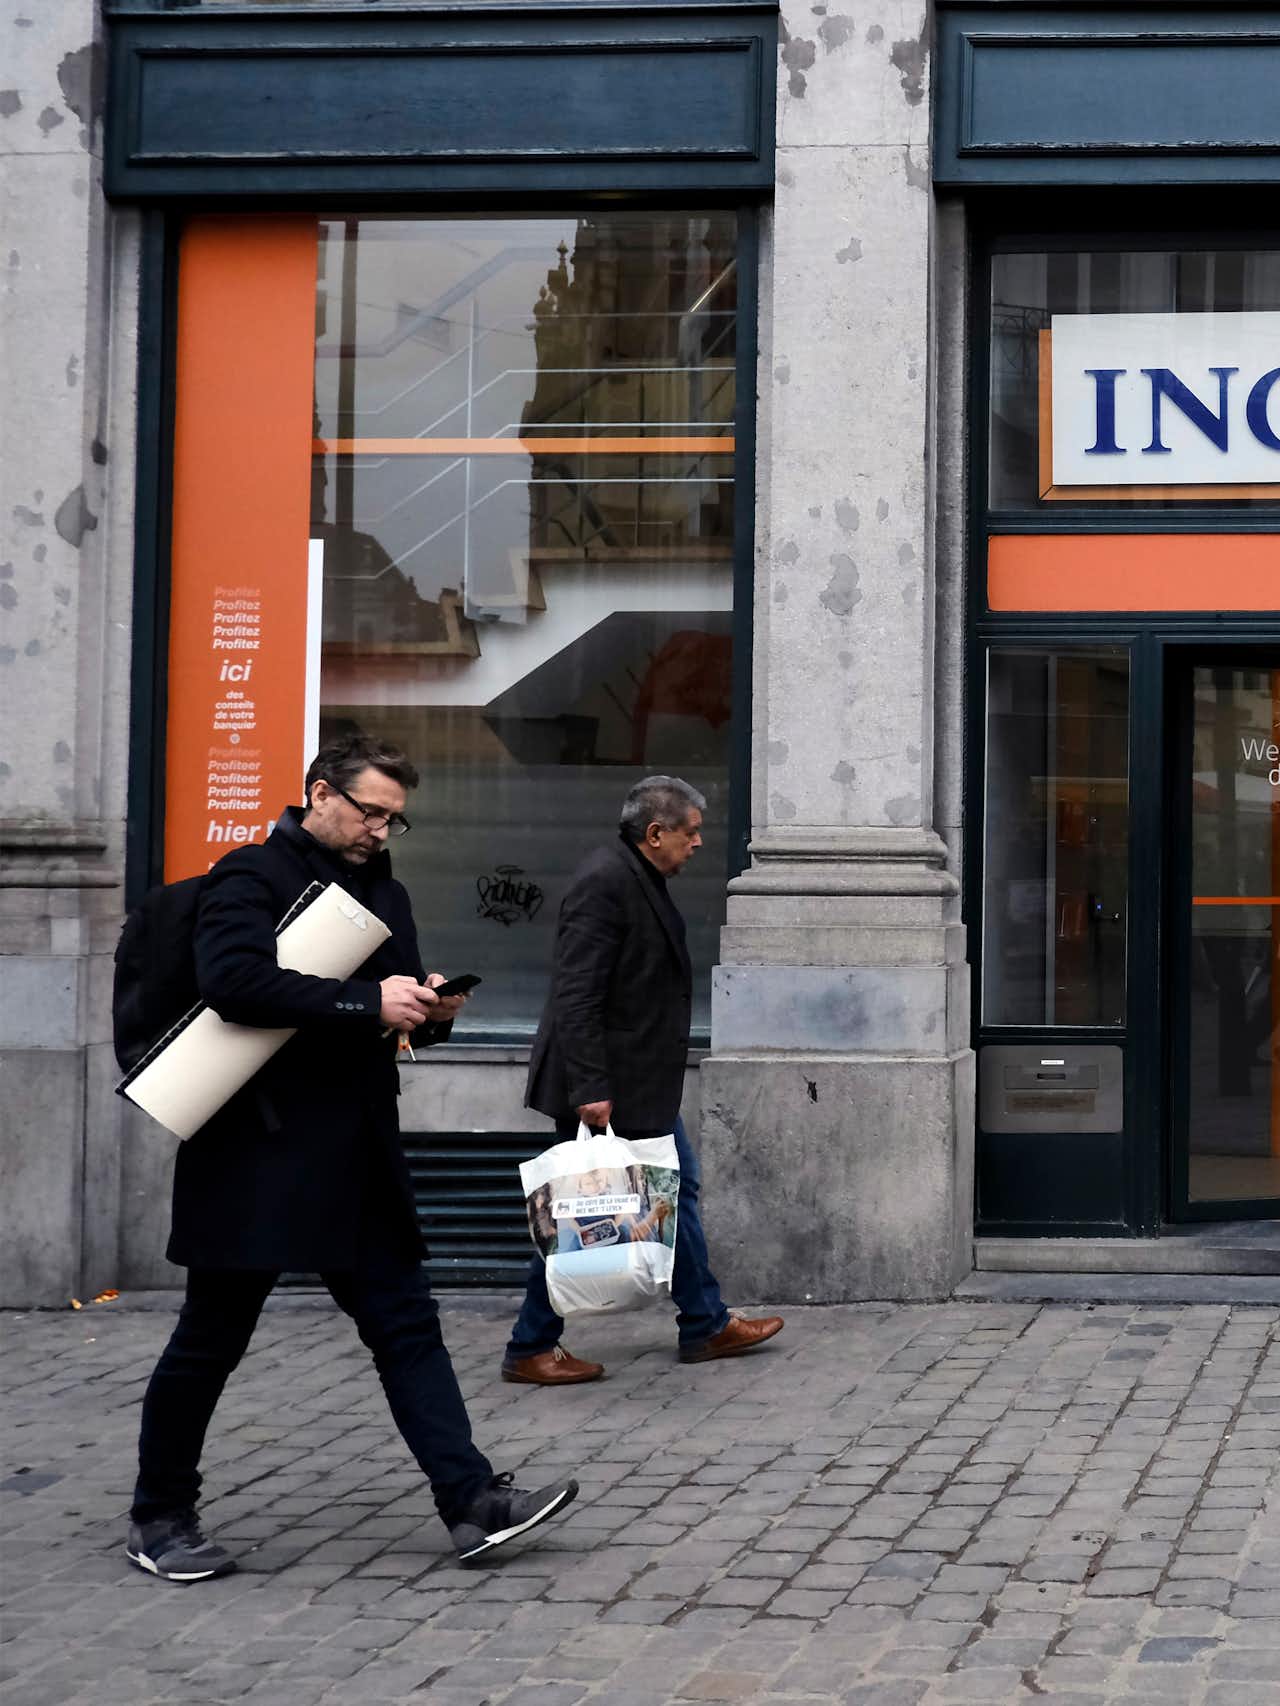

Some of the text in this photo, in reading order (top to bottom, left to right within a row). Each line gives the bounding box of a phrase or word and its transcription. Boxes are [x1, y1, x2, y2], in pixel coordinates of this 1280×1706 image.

[213, 600, 260, 610] Profitez
[213, 613, 260, 623] Profitez
[213, 626, 260, 636] Profitez
[213, 639, 260, 649] Profitez
[219, 659, 253, 682] ici
[226, 690, 244, 699] des
[215, 701, 255, 709] conseils
[215, 710, 255, 719] de votre
[213, 720, 257, 731] banquier
[208, 761, 261, 770] Profiteer
[208, 774, 261, 783] Profiteer
[208, 787, 261, 796] Profiteer
[208, 800, 261, 810] Profiteer
[207, 820, 262, 843] hier
